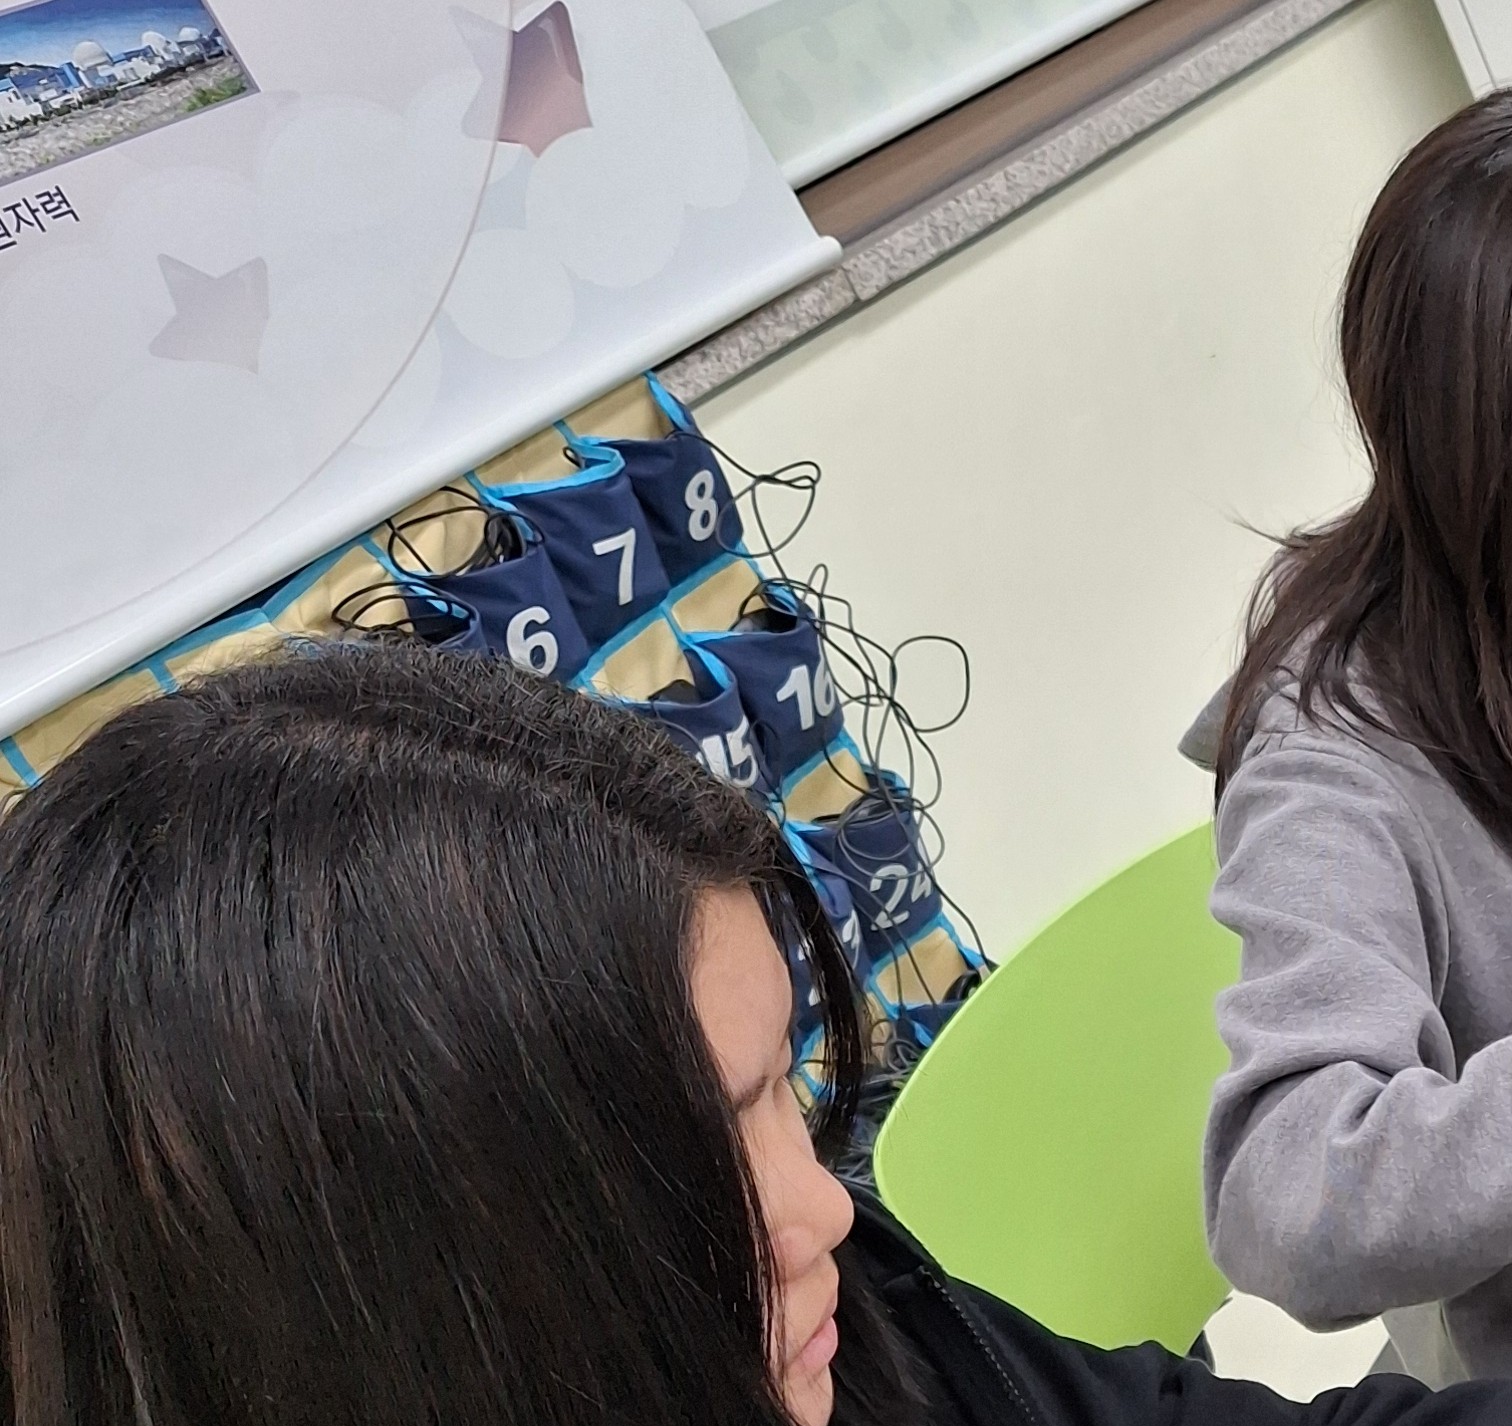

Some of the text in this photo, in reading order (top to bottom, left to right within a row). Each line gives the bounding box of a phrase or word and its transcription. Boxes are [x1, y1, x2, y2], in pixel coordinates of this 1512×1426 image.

[685, 469, 719, 542] 8
[592, 527, 636, 606] 7
[506, 605, 559, 678] 6
[776, 656, 836, 731] 16
[696, 713, 760, 788] 15
